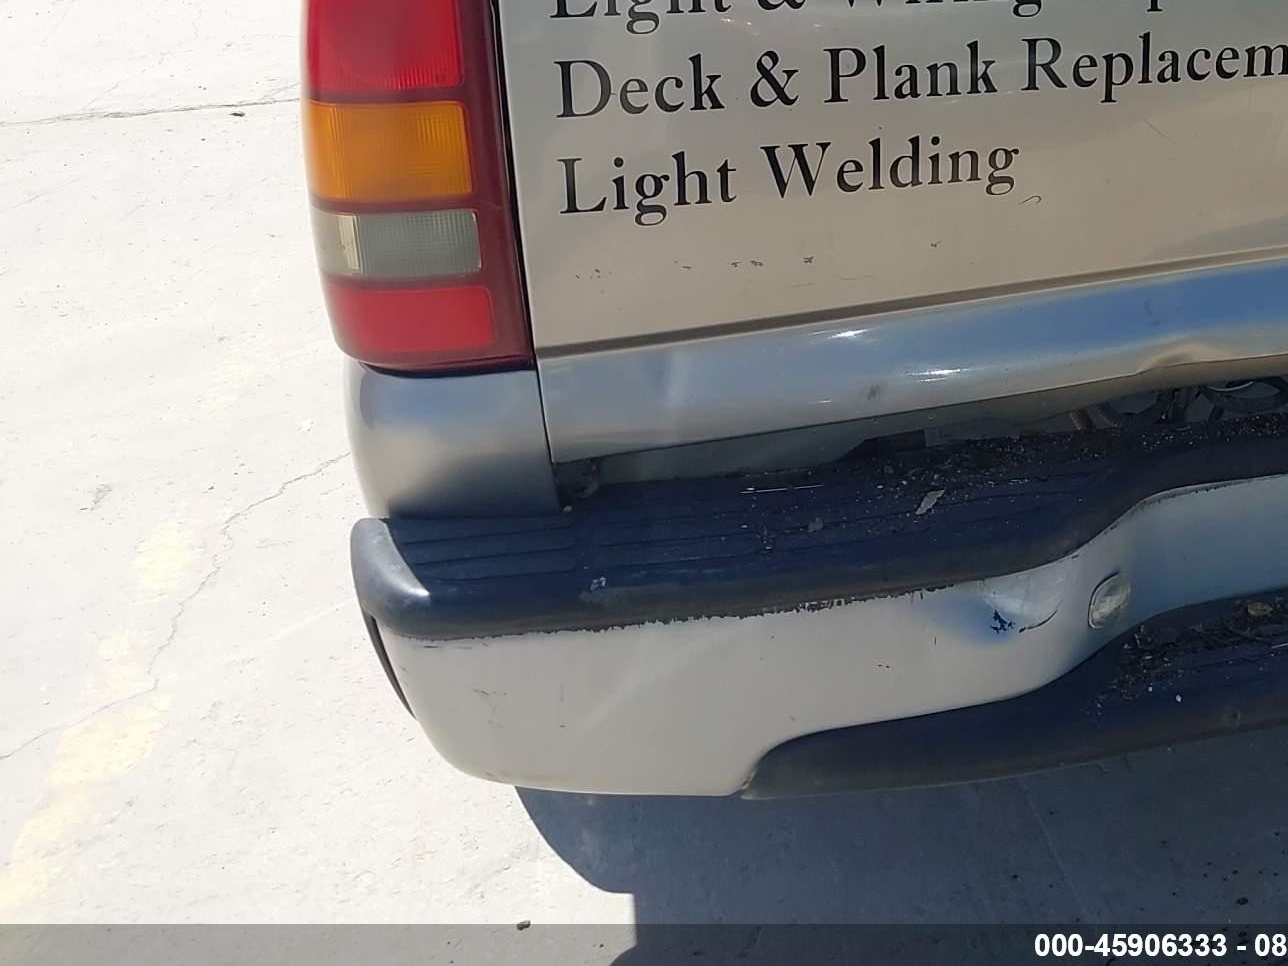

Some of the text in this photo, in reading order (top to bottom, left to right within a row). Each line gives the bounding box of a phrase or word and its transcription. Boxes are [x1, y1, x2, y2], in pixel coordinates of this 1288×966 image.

[555, 53, 726, 119] Deck
[750, 50, 800, 108] &
[823, 44, 998, 104] Plank
[558, 135, 1020, 227] Light Welding
